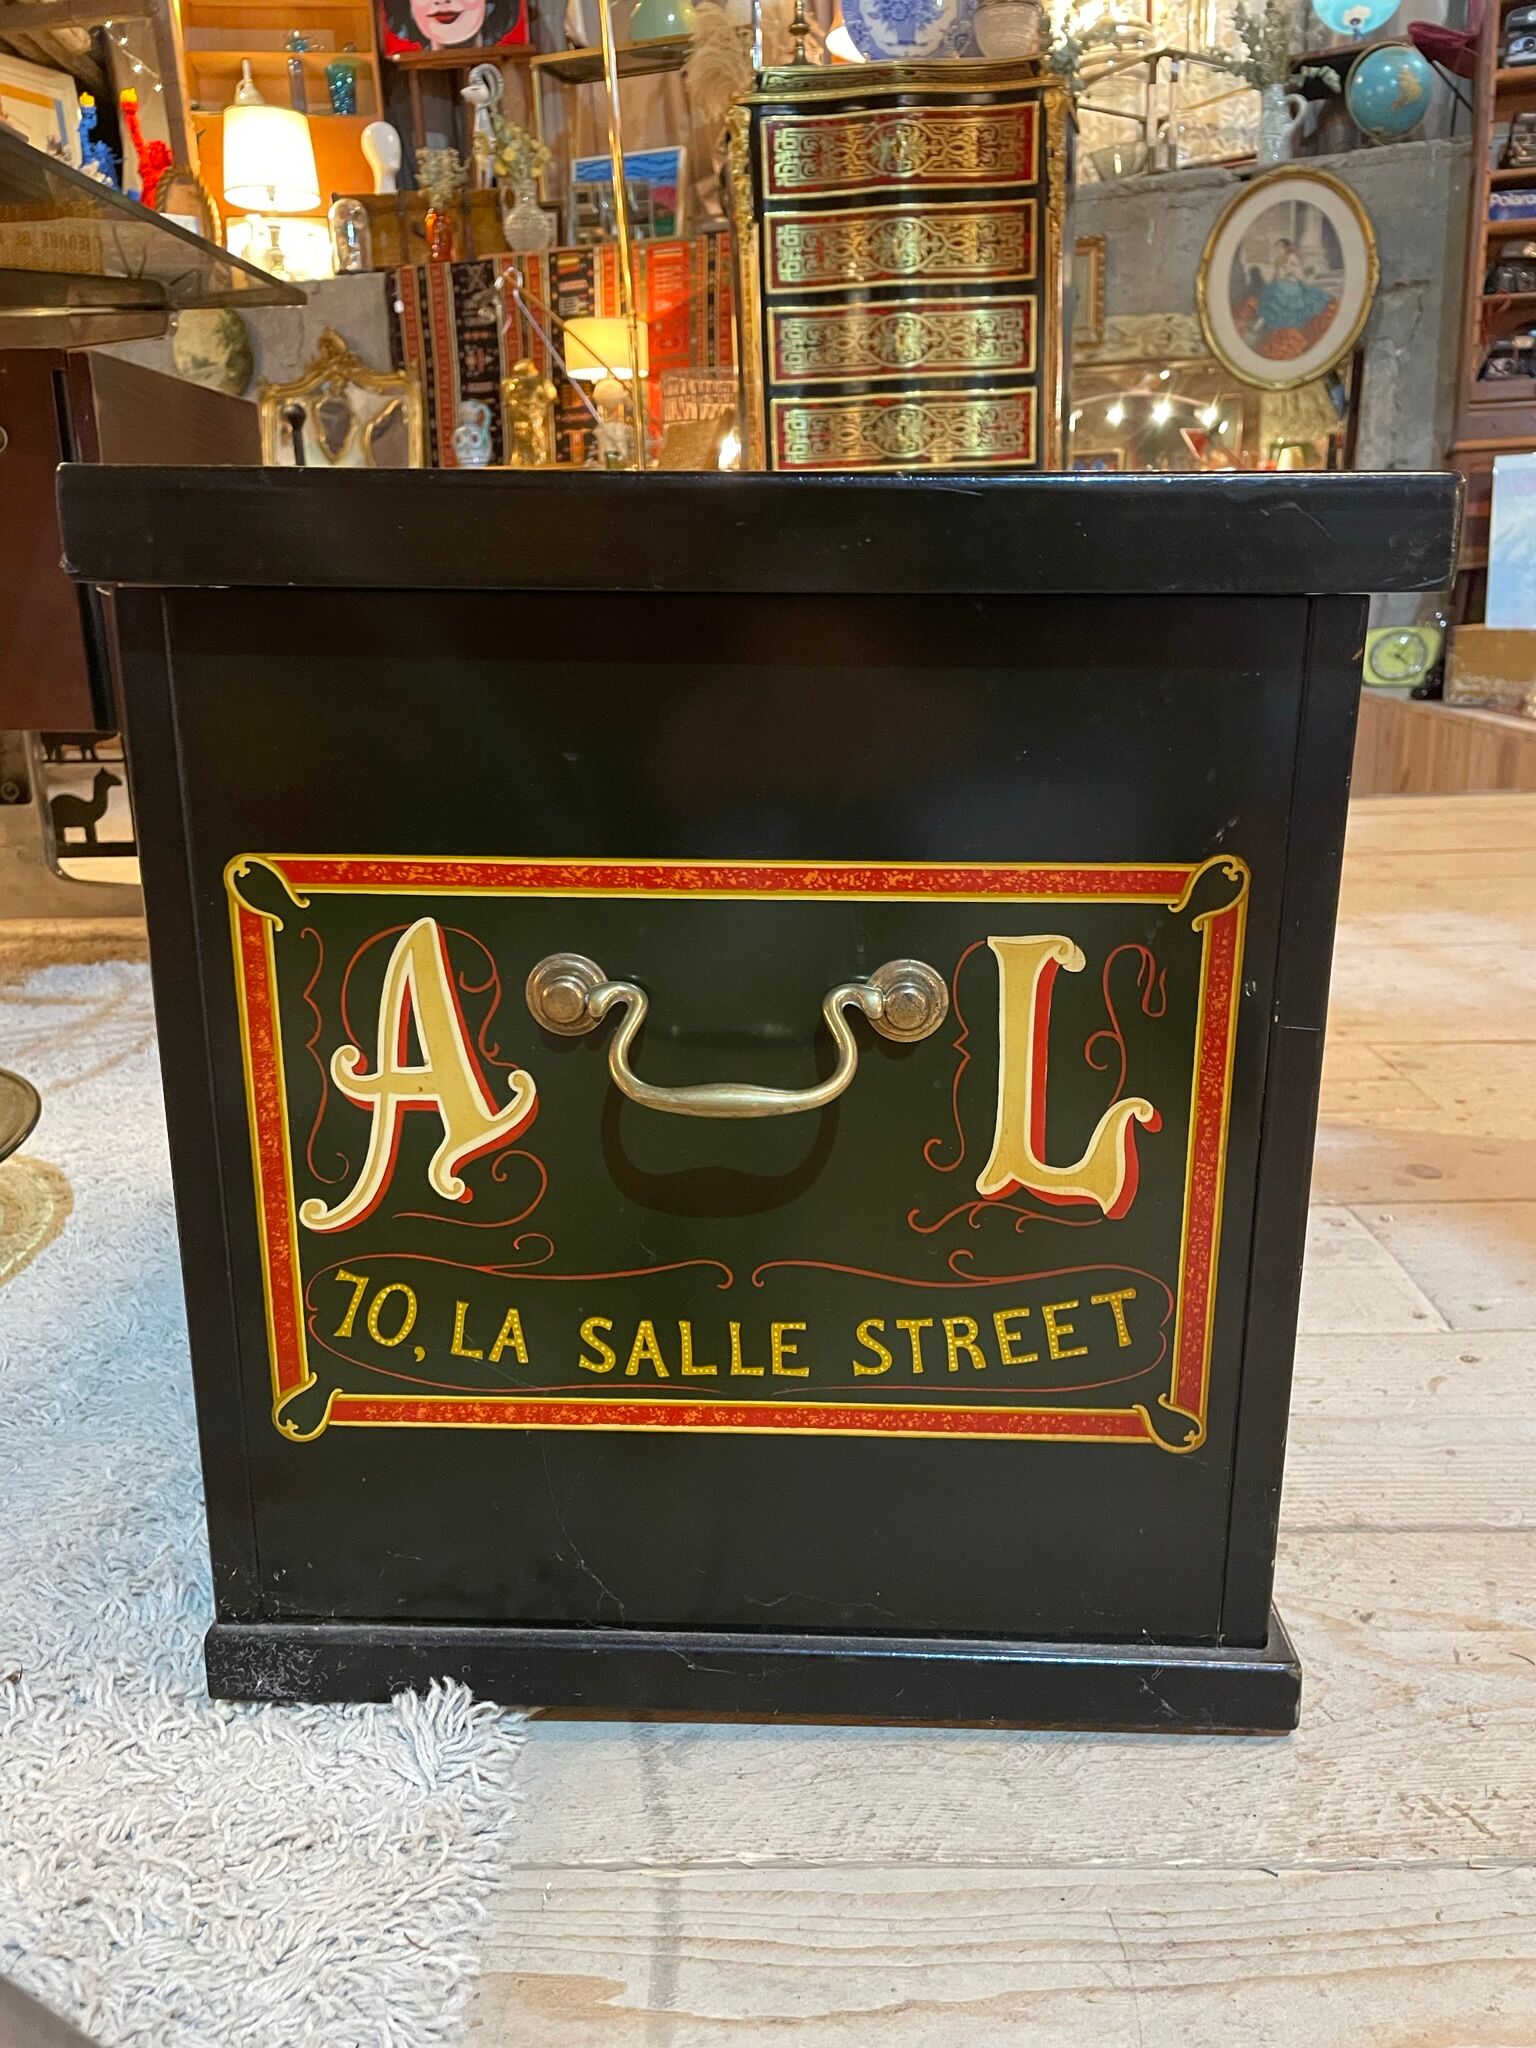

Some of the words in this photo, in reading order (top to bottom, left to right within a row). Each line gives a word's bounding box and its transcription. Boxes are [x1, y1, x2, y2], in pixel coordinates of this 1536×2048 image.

[299, 917, 539, 1234] A
[976, 934, 1163, 1219] L
[334, 1269, 426, 1362] 70,
[450, 1301, 529, 1363] LA
[579, 1317, 810, 1378] SALLE
[853, 1288, 1137, 1376] STREET
